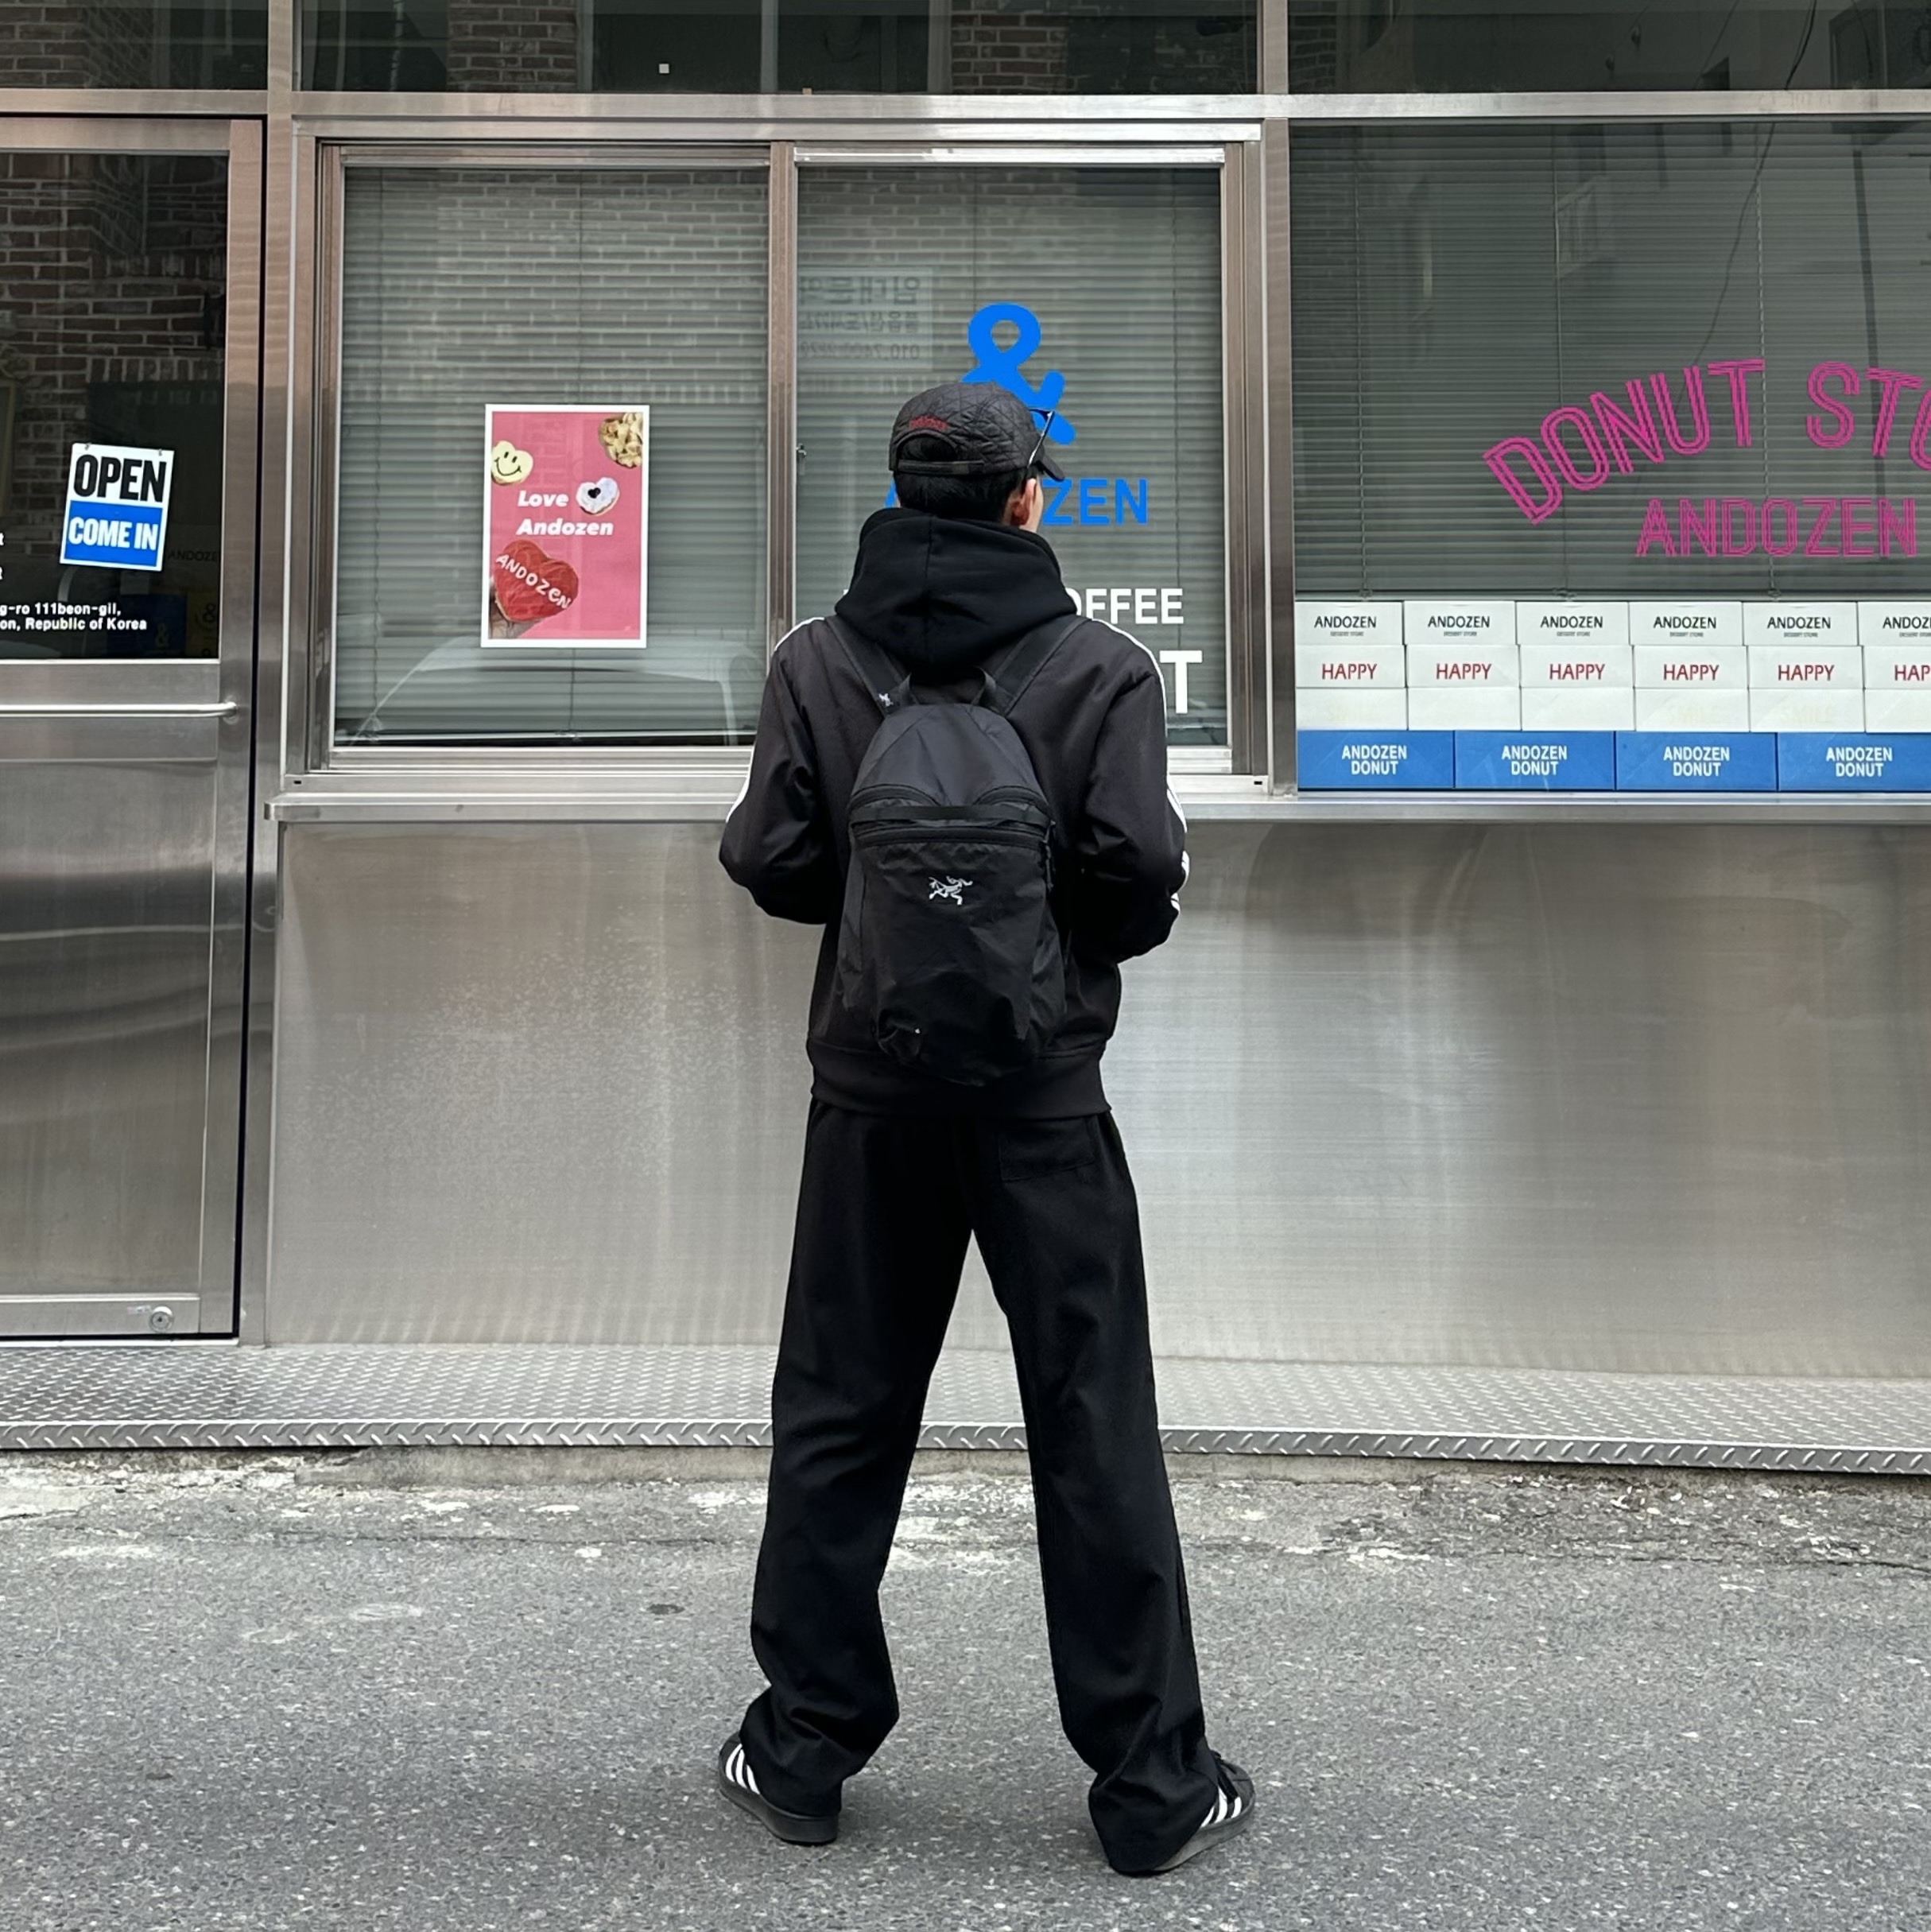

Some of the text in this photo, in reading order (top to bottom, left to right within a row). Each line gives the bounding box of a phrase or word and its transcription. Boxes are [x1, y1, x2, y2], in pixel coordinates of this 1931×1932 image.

[1483, 359, 1765, 525] DONUT
[73, 454, 167, 502] OPEN
[518, 490, 569, 507] Love
[68, 516, 158, 551] COME IN
[516, 518, 614, 536] Andozen
[1635, 498, 1917, 557] ANDOZEN
[35, 602, 122, 617] 111beon-gil,
[25, 617, 86, 632] Republic
[89, 617, 103, 630] of
[107, 617, 148, 630] Korea
[1314, 615, 1377, 629] ANDOZEN
[1428, 615, 1491, 629] ANDOZEN
[1540, 615, 1603, 629] ANDOZEN
[1654, 616, 1717, 630] ANDOZEN
[1766, 616, 1832, 630] ANDOZEN
[1883, 616, 1931, 629] ANDOZ
[1321, 663, 1378, 680] HAPPY
[1436, 663, 1492, 680] HAPPY
[1549, 663, 1606, 681] HAPPY
[1663, 664, 1720, 681] HAPPY
[1777, 664, 1835, 681] HAPPY
[1894, 664, 1931, 681] HAP
[1159, 650, 1203, 714] T
[1341, 744, 1408, 760] ANDOZEN
[1501, 745, 1568, 761] ANDOZEN
[1663, 746, 1730, 762] ANDOZEN
[1825, 747, 1893, 762] ANDOZEN
[1351, 760, 1399, 775] DONUT
[1510, 761, 1559, 776] DONUT
[1673, 762, 1722, 778] DONUT
[1835, 762, 1883, 778] DONUT
